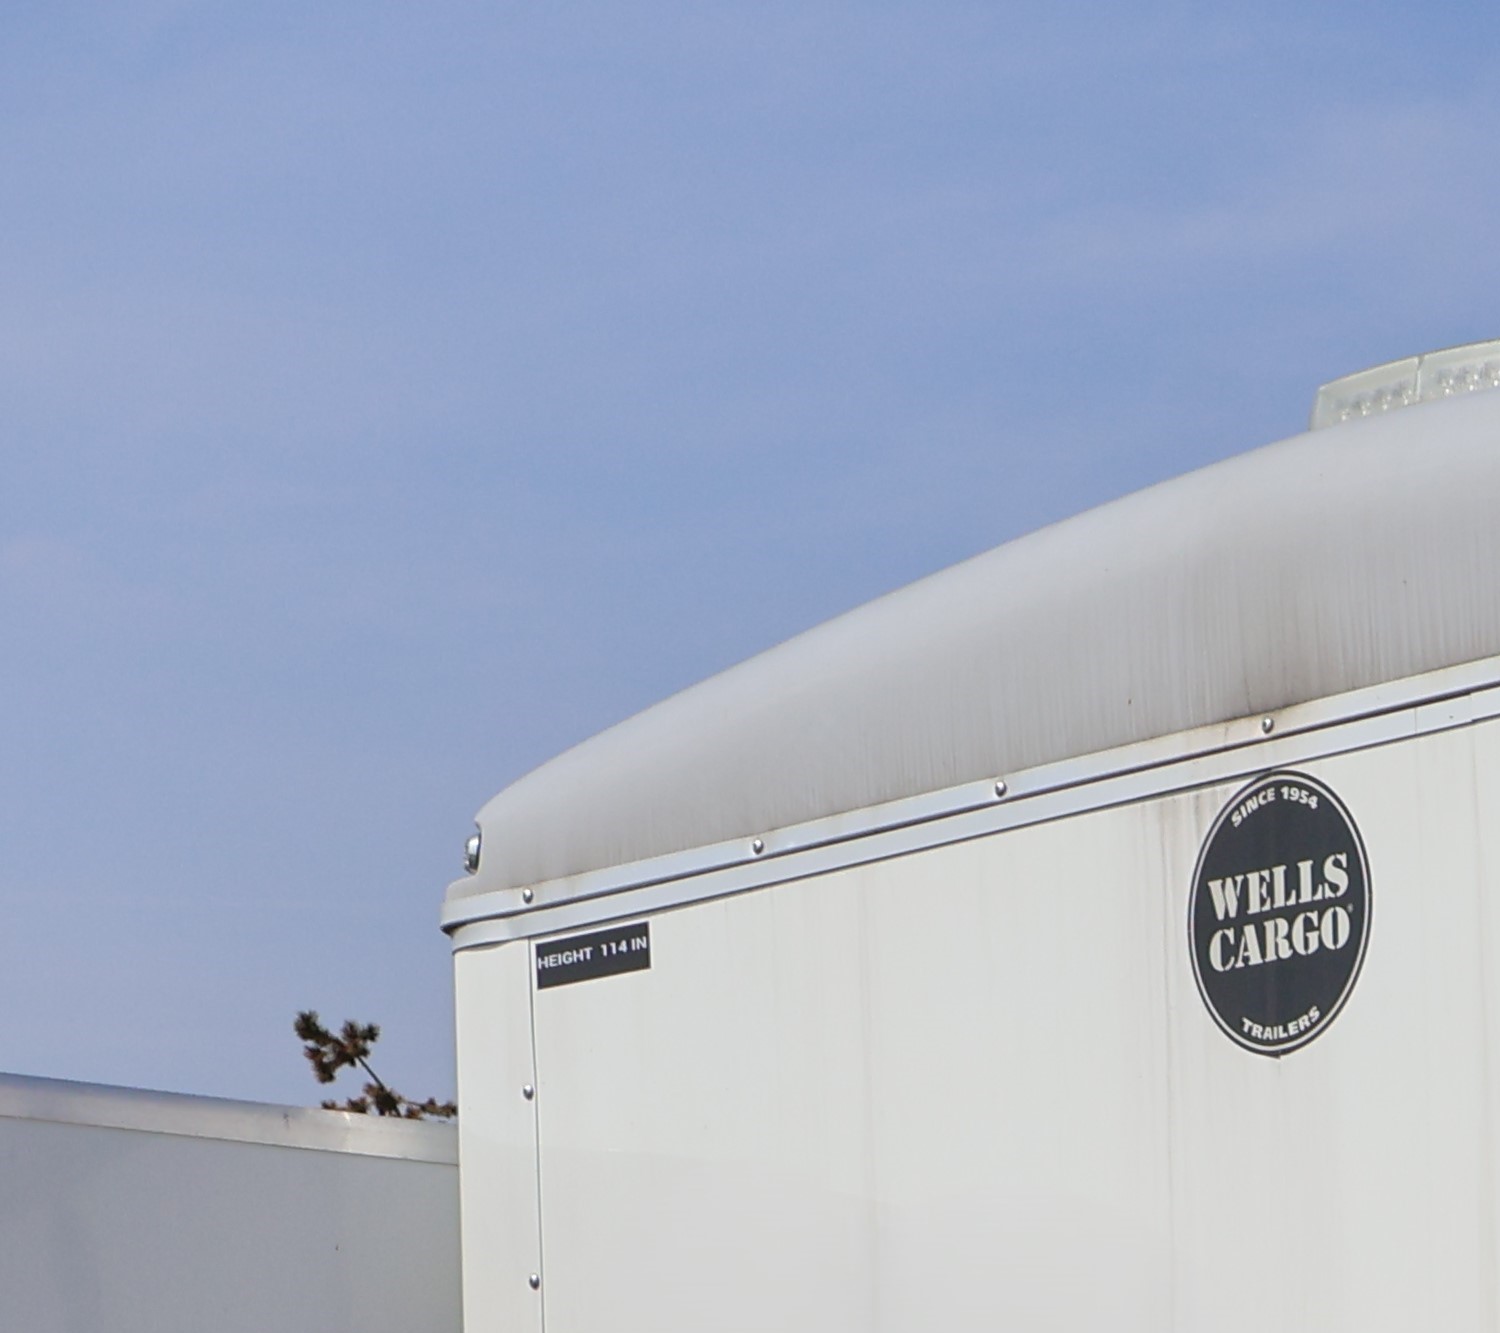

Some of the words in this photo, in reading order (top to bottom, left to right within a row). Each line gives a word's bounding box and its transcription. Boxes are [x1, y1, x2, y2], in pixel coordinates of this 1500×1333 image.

[1231, 787, 1276, 828] SINCE
[1280, 785, 1319, 811] 1954
[1207, 852, 1350, 921] WELLS
[537, 946, 593, 970] HEIGHT
[600, 939, 627, 957] 114
[631, 936, 648, 951] IN
[1208, 905, 1351, 973] CARGO
[1241, 1005, 1321, 1041] TRAILERS
